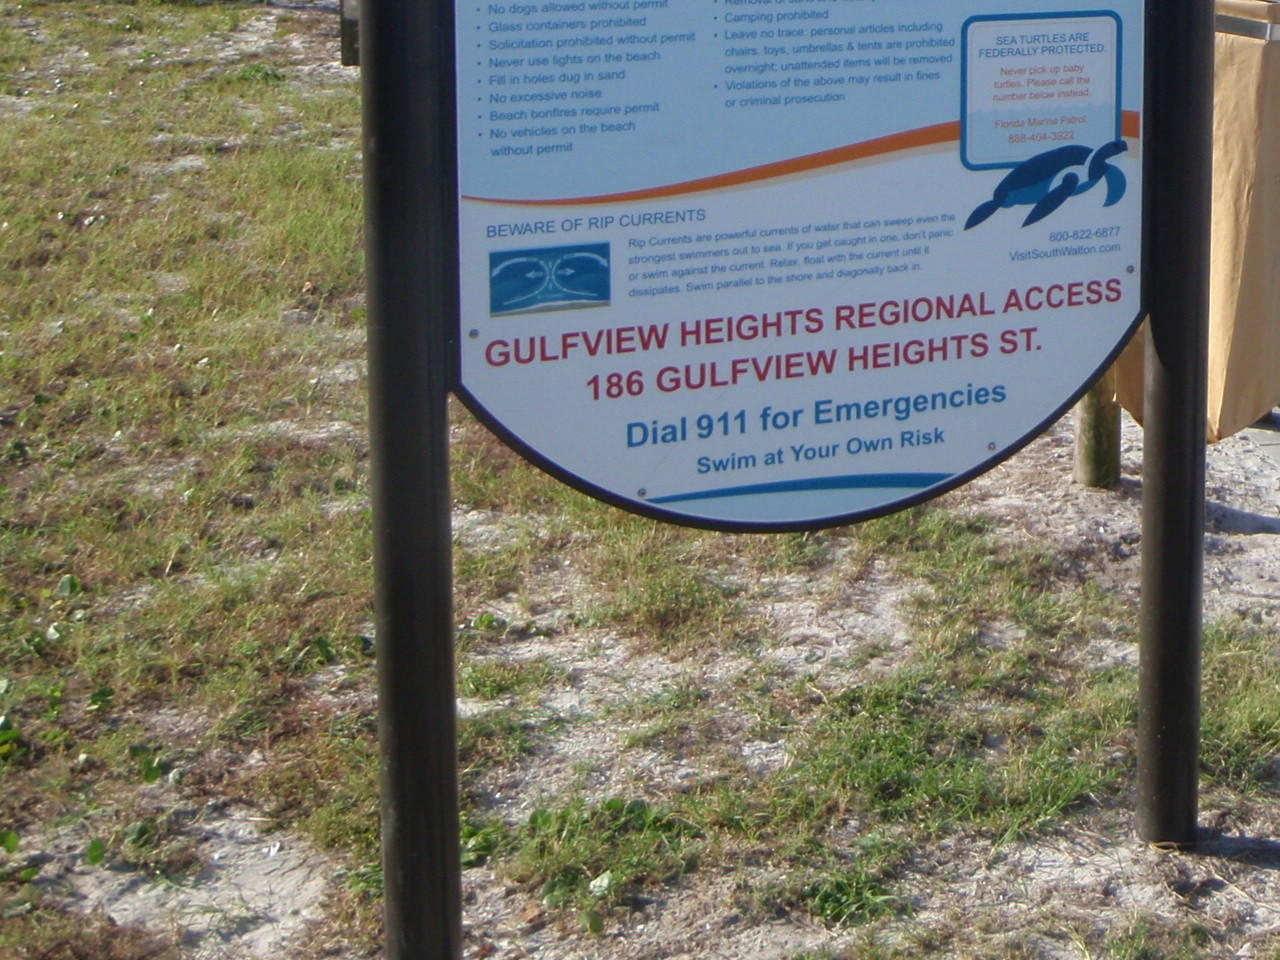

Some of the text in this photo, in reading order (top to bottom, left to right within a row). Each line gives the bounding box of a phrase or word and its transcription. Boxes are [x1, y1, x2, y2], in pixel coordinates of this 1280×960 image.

[489, 0, 668, 15] No dogs allowed without permit
[489, 17, 646, 32] Glass containers prohibited
[725, 10, 829, 24] Camping prohibited
[489, 33, 695, 50] Solicitation prohibited without permit
[997, 33, 1089, 45] SEA TURTLES ARE
[489, 58, 524, 68] Never
[528, 58, 549, 66] use
[553, 55, 583, 67] lights
[605, 53, 622, 62] the
[626, 51, 660, 62] beach
[979, 44, 1104, 58] FEDERALLY PROTECTED
[489, 75, 506, 85] Fill
[510, 76, 520, 84] in
[524, 75, 555, 84] holes
[559, 73, 580, 84] dug
[598, 70, 625, 80] sand
[726, 81, 777, 90] Violations
[780, 78, 791, 87] of
[794, 78, 810, 87] the
[814, 77, 845, 86] above
[848, 77, 870, 85] may
[873, 73, 901, 82] result
[917, 72, 940, 80] fines
[490, 91, 602, 103] No excessive noise
[725, 94, 845, 108] or criminal prosecution
[490, 104, 659, 121] Beach bonfires require permit
[490, 122, 636, 139] No vehicles on the beach
[491, 143, 573, 156] without permit
[487, 209, 706, 238] BEWARE OF RIP CURRENTS
[1049, 227, 1120, 242] 800-822-6877
[1010, 244, 1120, 261] VisitSouthWalton.com
[486, 279, 1121, 366] GULFVIEW HEIGHTS REGIONAL ACCESS
[587, 328, 1041, 400] 186 GULFVIEW HEIGHTS ST.
[627, 386, 1006, 448] Dial 911 for Emergencies
[698, 428, 944, 474] Swim at Your Own Risk
